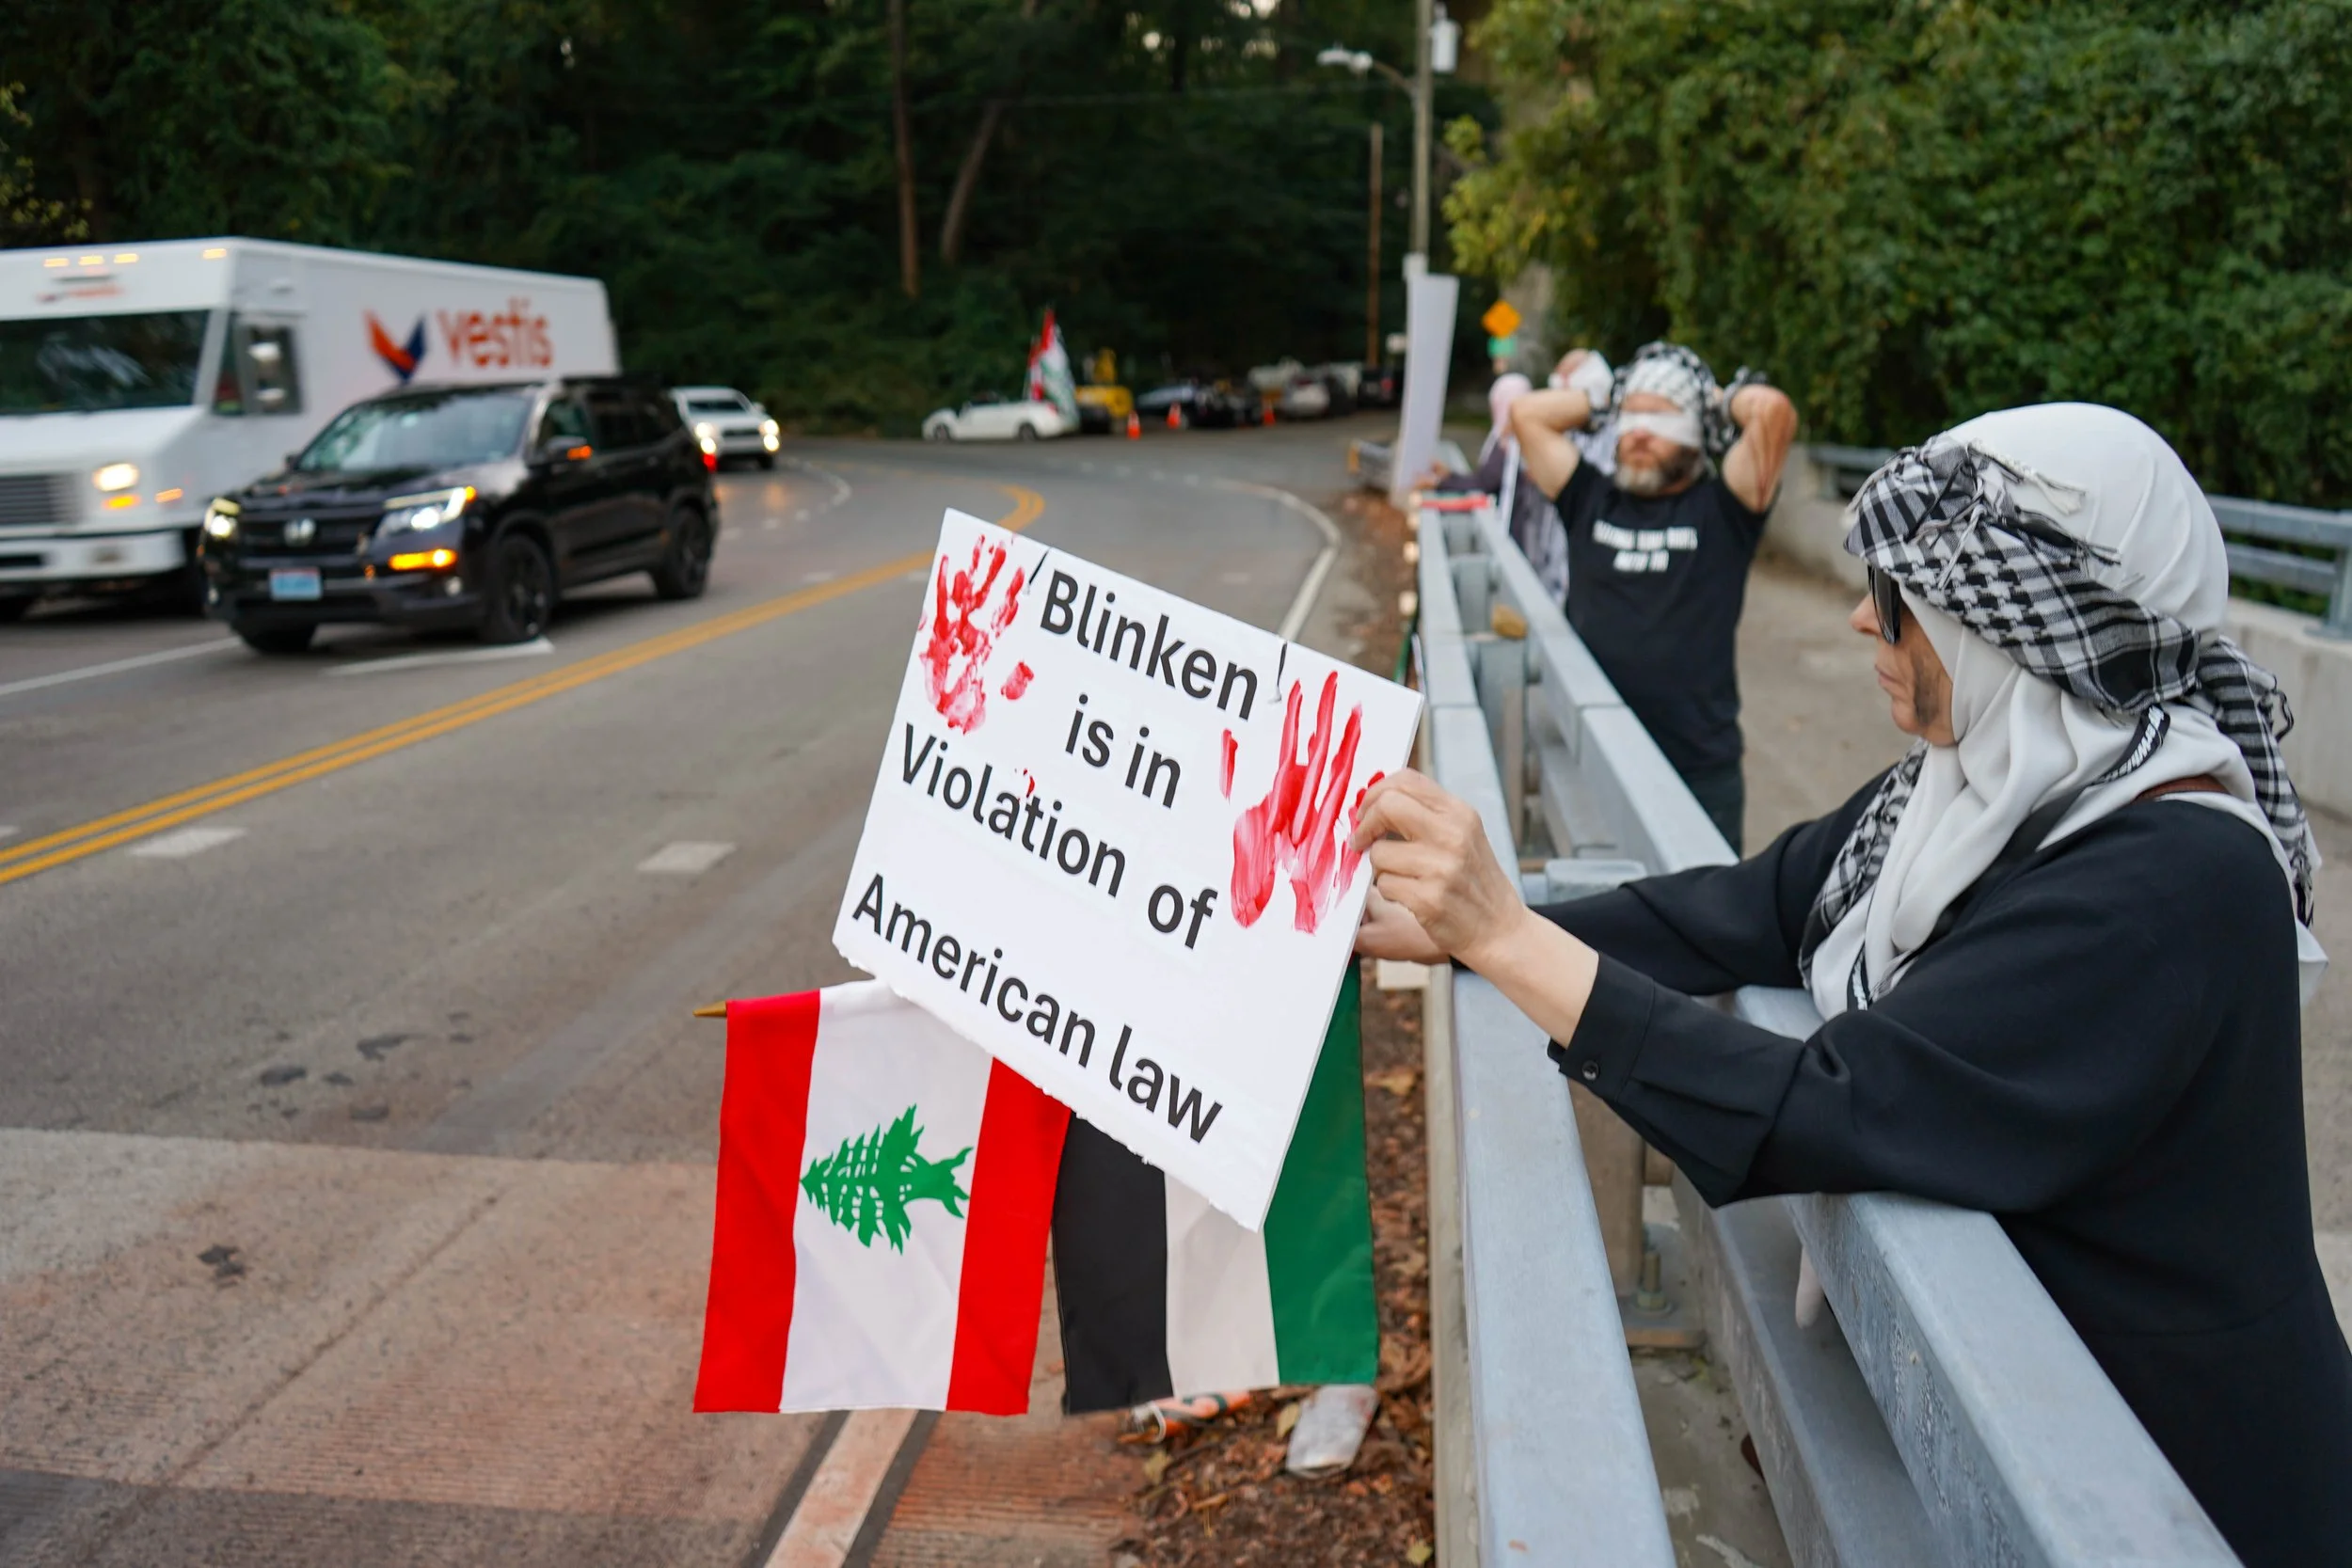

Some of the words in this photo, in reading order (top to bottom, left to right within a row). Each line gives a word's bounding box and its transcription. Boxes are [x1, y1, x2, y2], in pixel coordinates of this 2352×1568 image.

[436, 296, 553, 368] vestis
[1040, 569, 1259, 721] Blinken
[1065, 694, 1114, 768] is
[1125, 726, 1181, 809] in
[902, 722, 1125, 898] Violation
[1148, 884, 1218, 950] of
[852, 874, 1096, 1069] American
[1108, 1024, 1223, 1144] law
